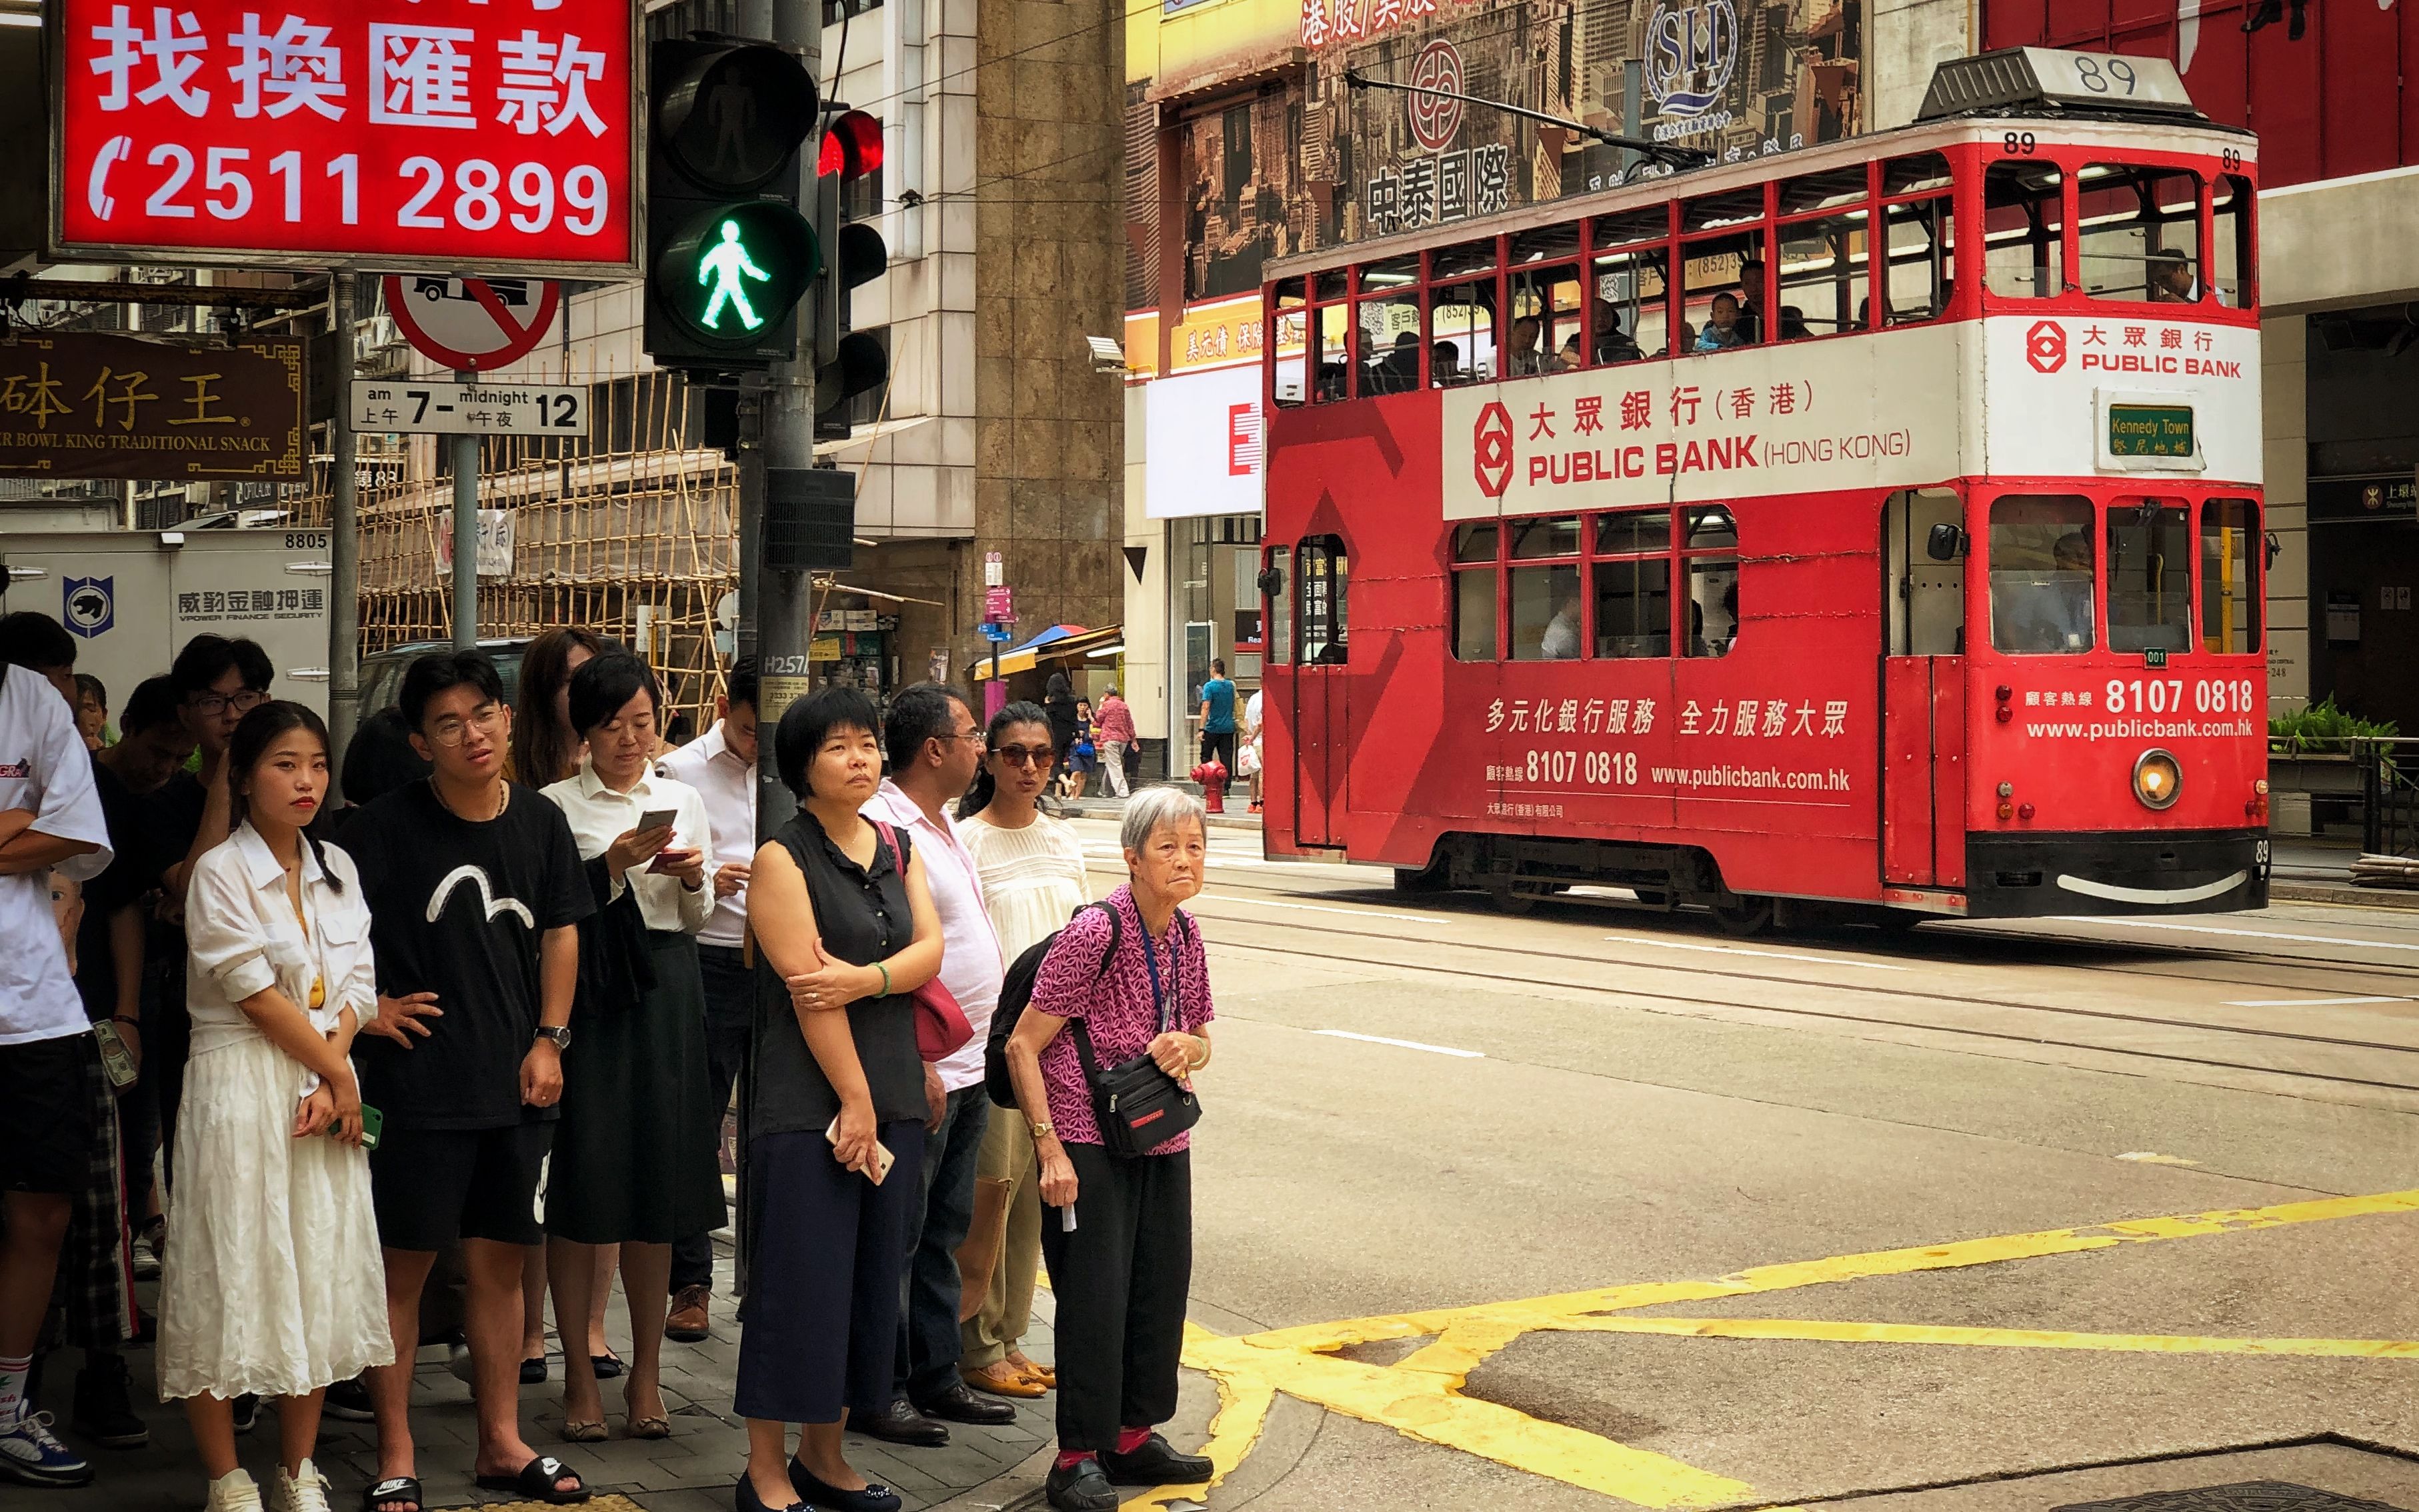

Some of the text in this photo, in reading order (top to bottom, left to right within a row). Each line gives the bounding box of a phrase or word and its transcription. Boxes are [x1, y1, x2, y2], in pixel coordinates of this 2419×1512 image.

[89, 5, 608, 137] 找換匯款
[2074, 55, 2137, 96] 89
[2004, 131, 2036, 155] 89
[2222, 147, 2241, 172] 89
[145, 143, 609, 236] 2511 2899
[1368, 143, 1509, 235] 中泰國際
[1186, 325, 1229, 362] 美元債
[2082, 325, 2213, 352] 大眾銀行
[2082, 354, 2242, 379] PUBLIC BANK
[0, 361, 237, 431] 砵仔王
[368, 389, 391, 400] am
[459, 391, 528, 406] midnight
[535, 394, 577, 427] 12
[361, 407, 399, 425] 上午
[2112, 417, 2189, 438] Kennedy Town
[0, 431, 272, 452] R BOWL KING TRADITIONAL SNACK
[1529, 429, 1911, 486] PUBLIC BANK (HONG KONG)
[285, 533, 327, 549] 8805
[179, 589, 323, 613] 威豹金融押運
[2148, 651, 2164, 663] 001
[2025, 679, 2253, 713] 顧客熱線 8107 0818
[1485, 697, 1848, 739] 多元化銀行服務 全力服務大眾
[2026, 718, 2253, 741] www.publicbank.com.hk
[1526, 750, 1576, 783] 8107
[1585, 751, 1638, 785] 0818
[1651, 764, 1850, 792] www.publicbank.com.hk
[2256, 840, 2268, 863] 89
[379, 1479, 407, 1490] NIKE
